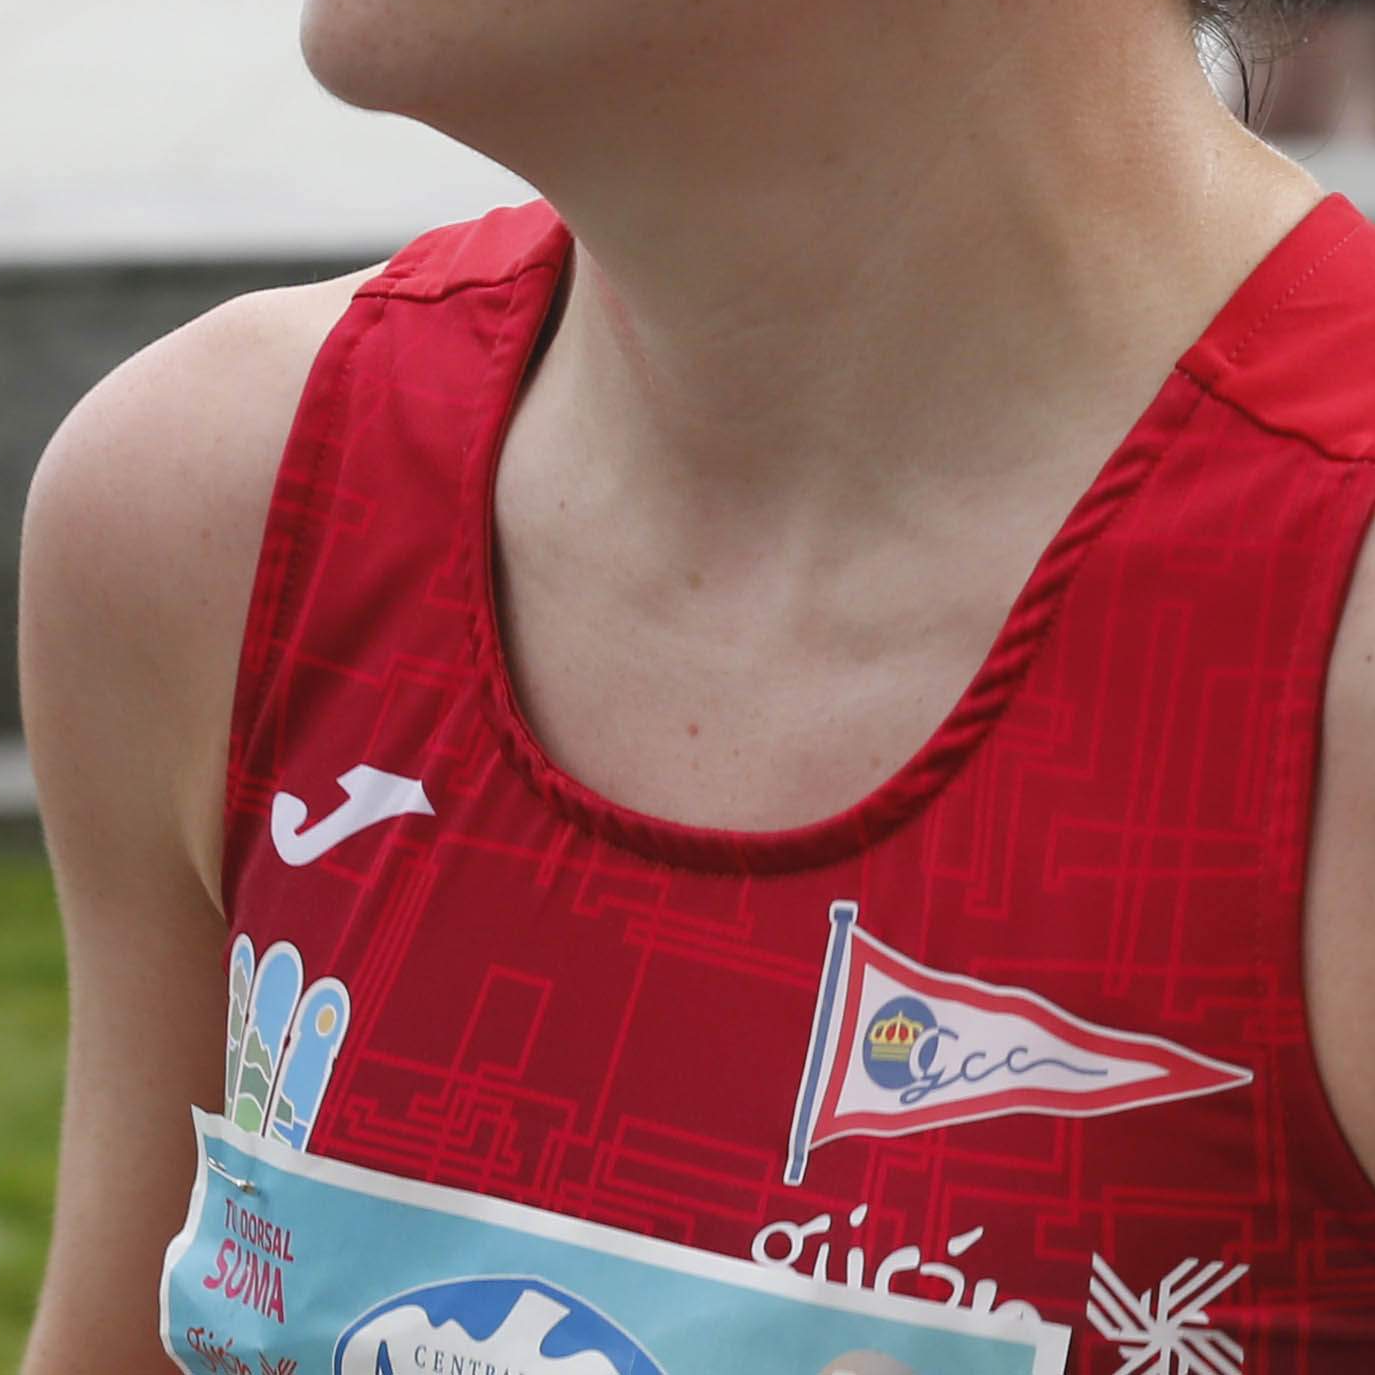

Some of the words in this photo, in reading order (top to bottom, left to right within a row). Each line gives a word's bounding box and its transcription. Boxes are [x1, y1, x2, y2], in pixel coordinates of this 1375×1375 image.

[240, 1207, 294, 1263] DORSAL
[202, 1237, 285, 1324] SUMA
[414, 1344, 525, 1375] CENTR
